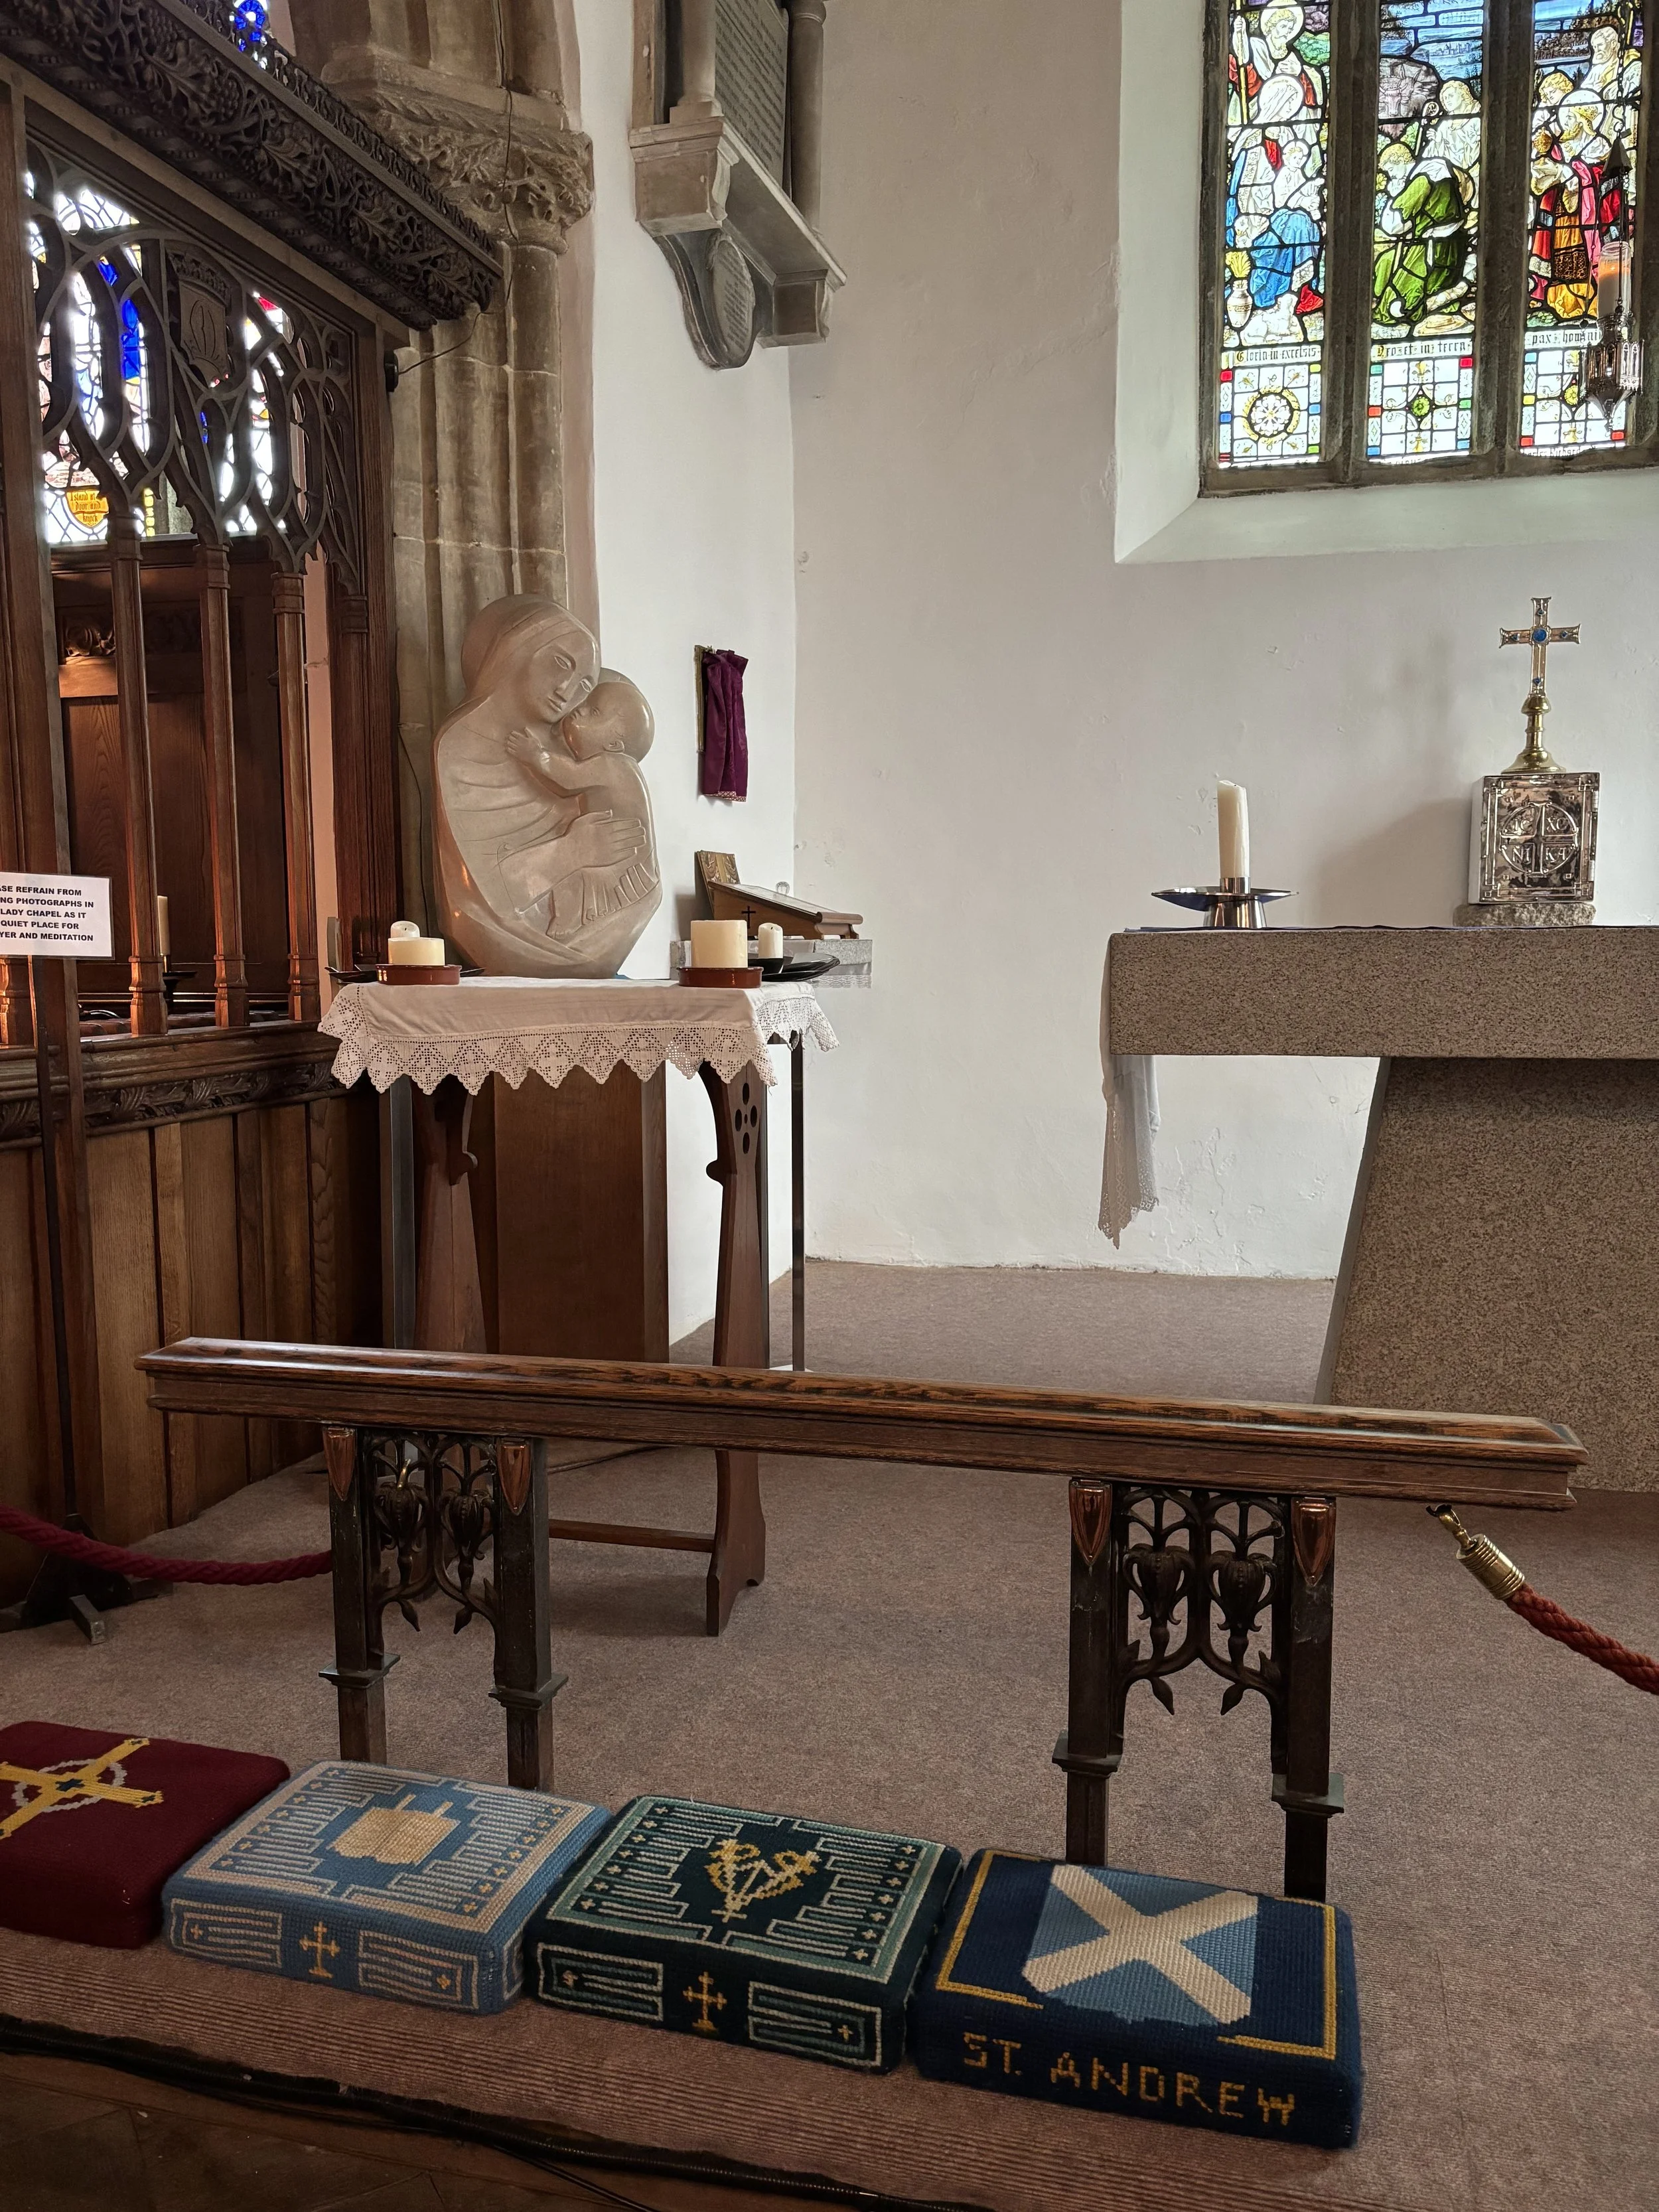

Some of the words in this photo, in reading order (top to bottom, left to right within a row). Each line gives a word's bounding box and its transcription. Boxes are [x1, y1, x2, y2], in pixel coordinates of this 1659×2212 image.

[1532, 334, 1551, 346] pax
[1270, 348, 1279, 360] in
[1281, 346, 1317, 359] excelsis
[16, 886, 54, 895] REFRAIN
[16, 898, 82, 907] PHOTOGRAPHS
[964, 2031, 1022, 2076] ST.
[1050, 2052, 1294, 2126] ANDREW
